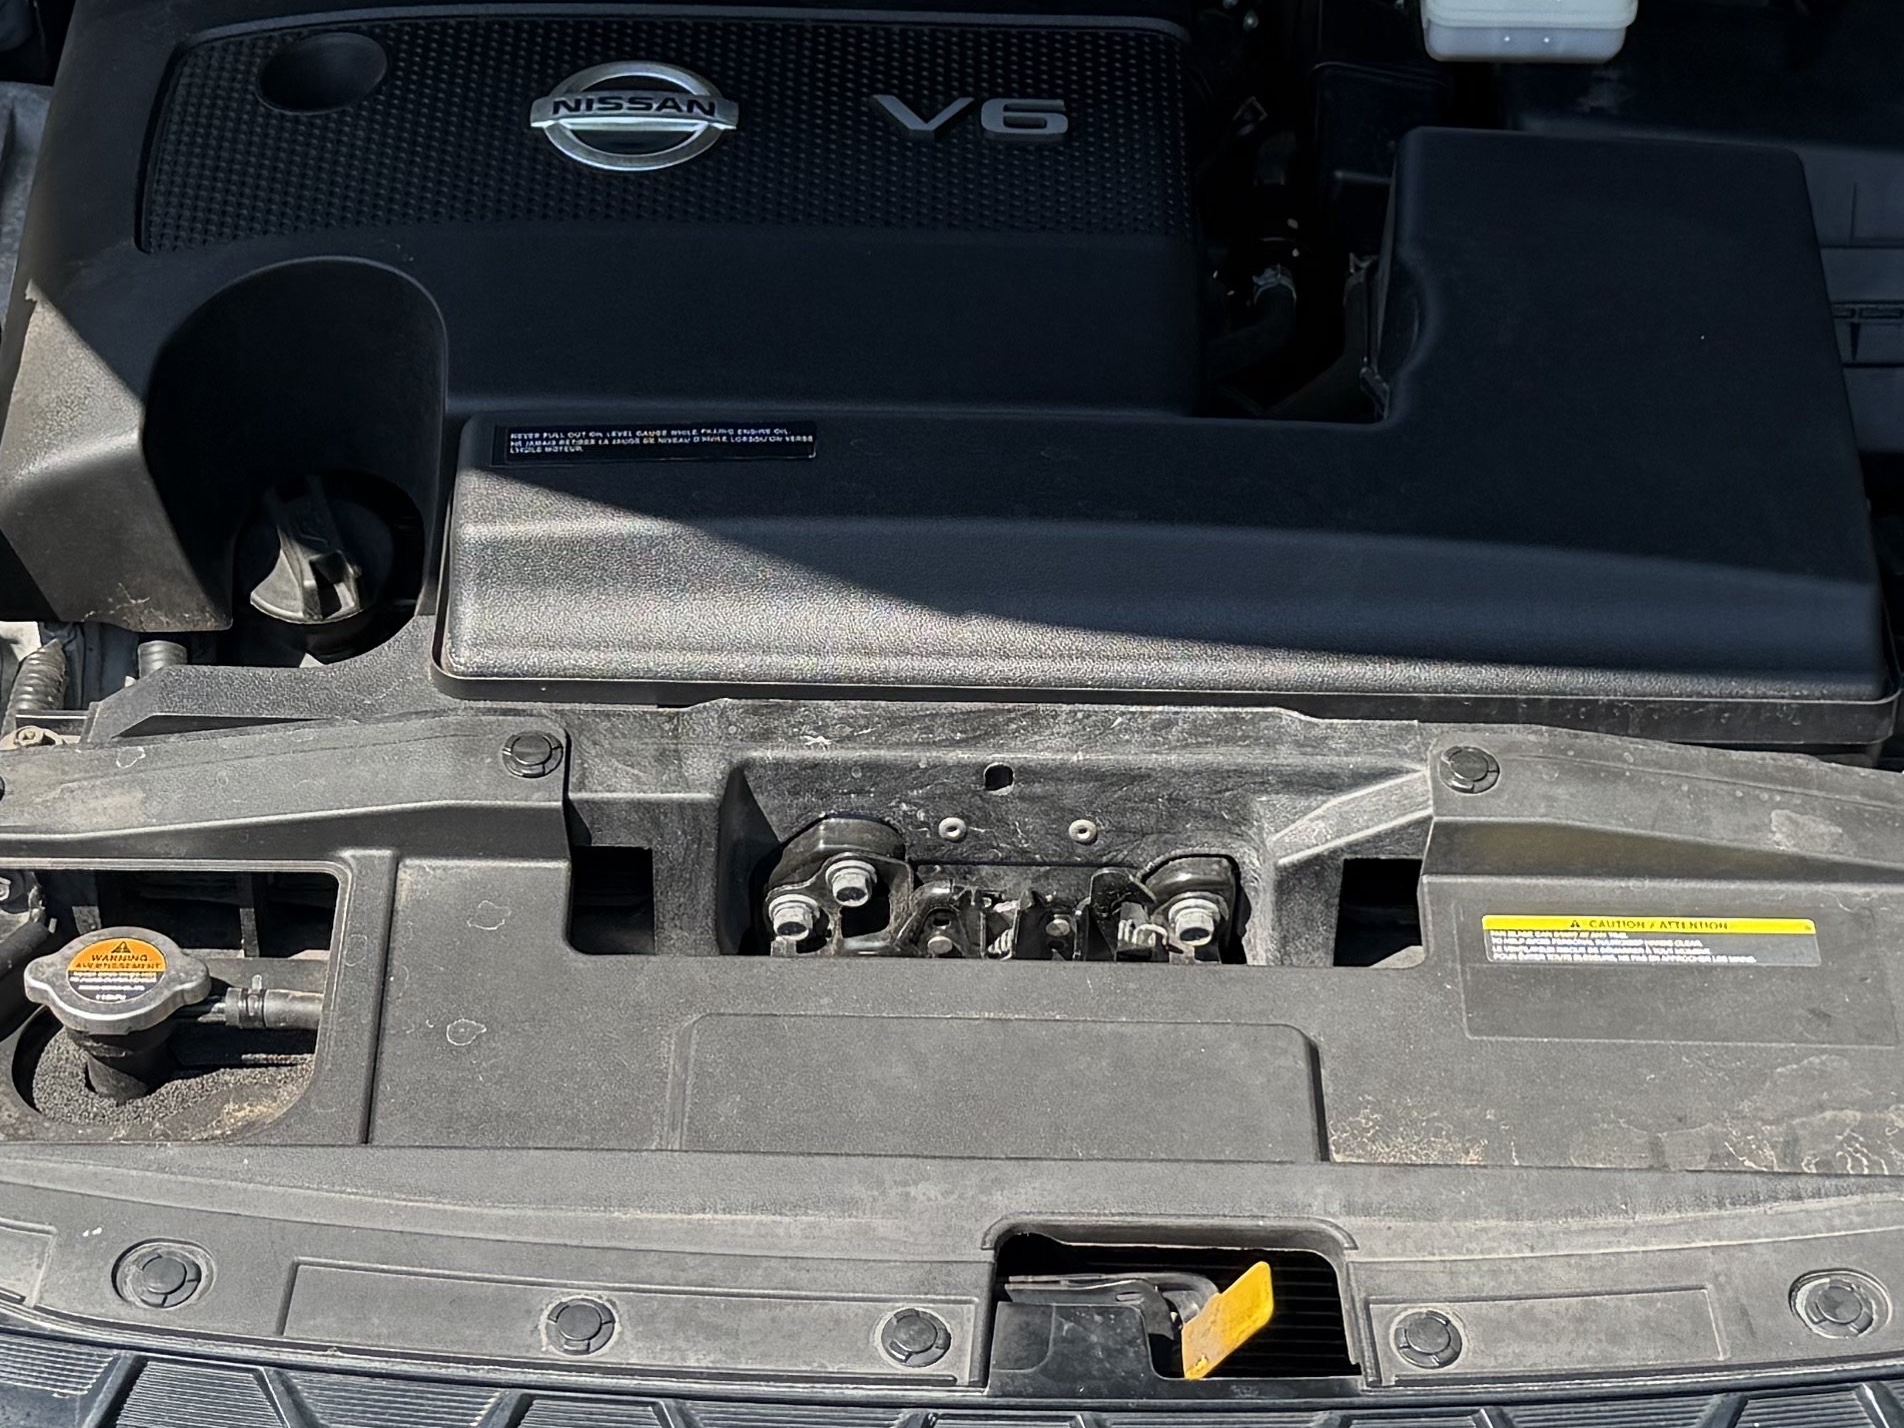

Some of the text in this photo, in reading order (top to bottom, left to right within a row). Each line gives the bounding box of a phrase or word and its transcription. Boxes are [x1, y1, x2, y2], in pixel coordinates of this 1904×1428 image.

[552, 96, 717, 117] NISSAN
[872, 93, 1069, 140] V6
[1589, 919, 1645, 928] CAUTION
[1659, 921, 1728, 930] ATTENTION
[91, 954, 149, 962] WARNING
